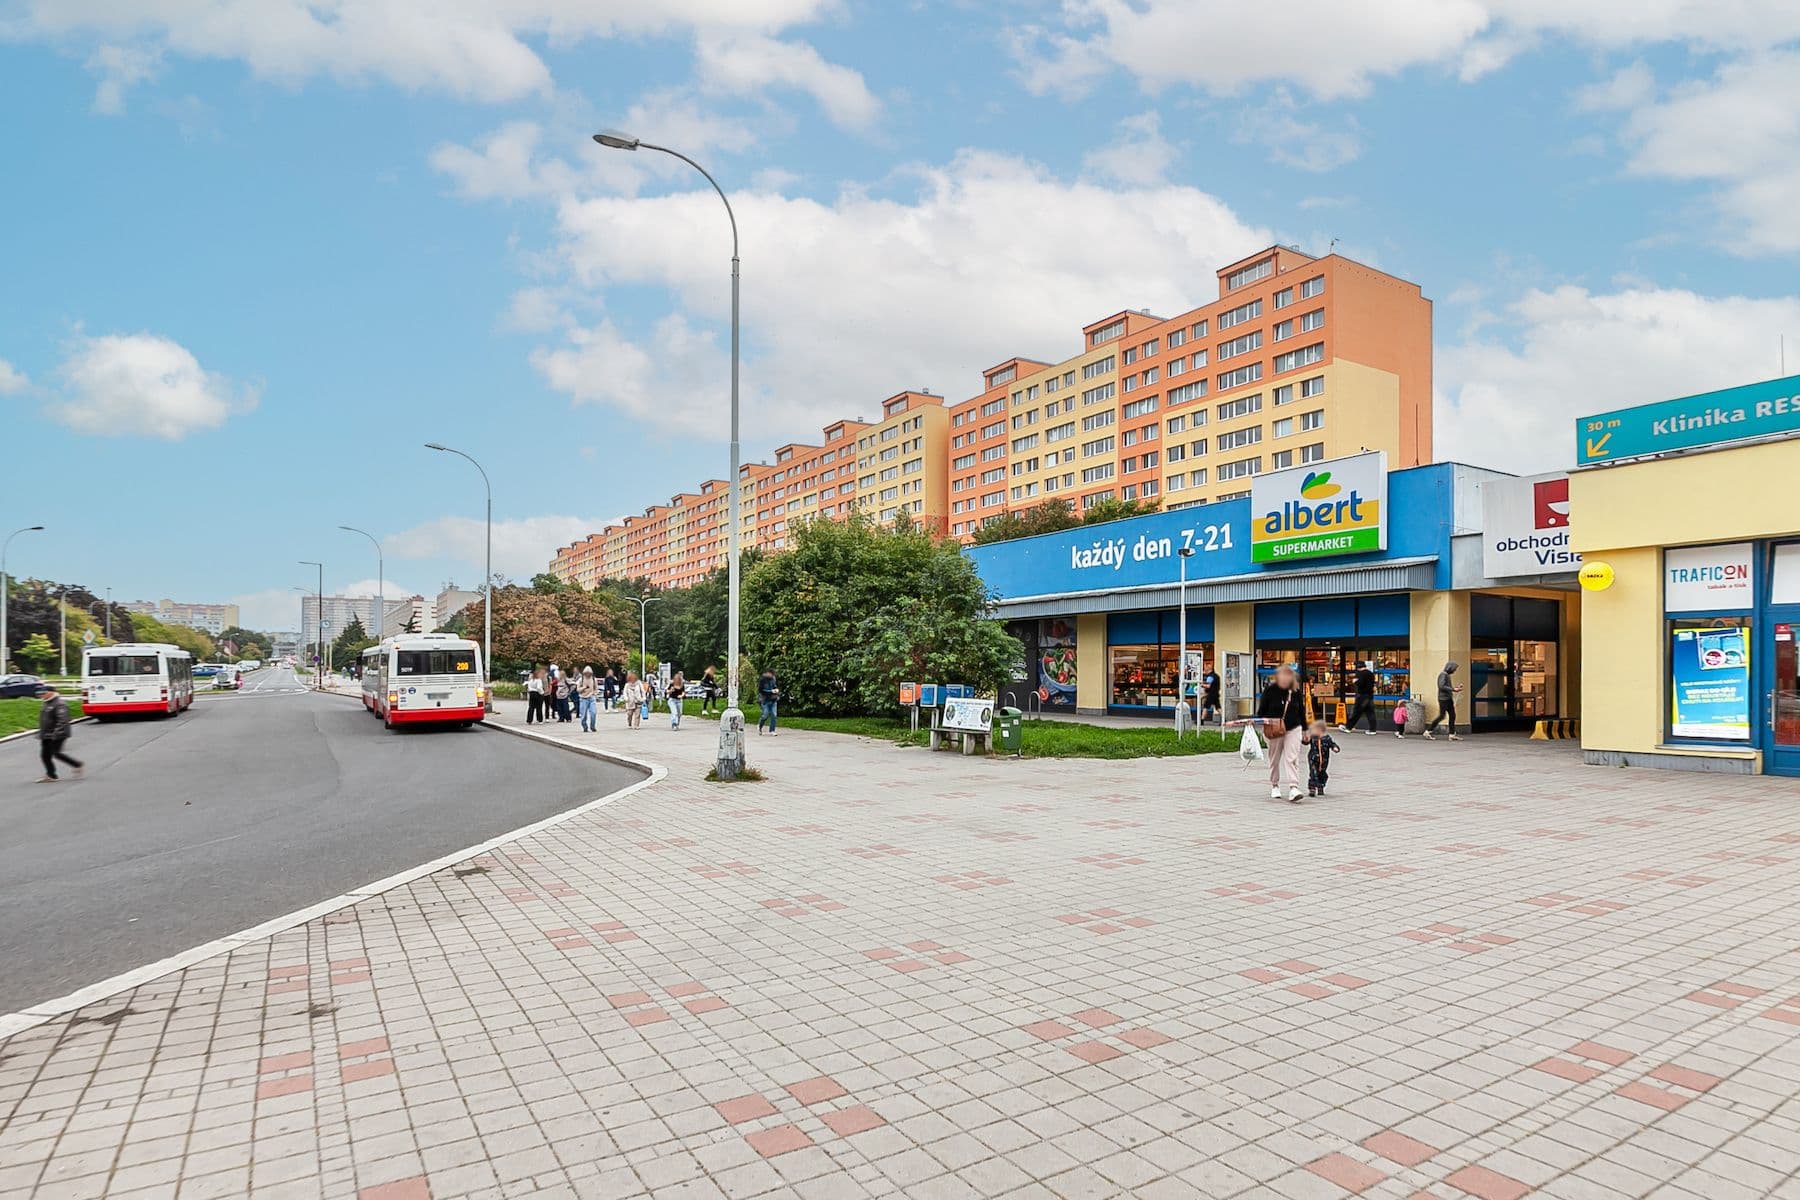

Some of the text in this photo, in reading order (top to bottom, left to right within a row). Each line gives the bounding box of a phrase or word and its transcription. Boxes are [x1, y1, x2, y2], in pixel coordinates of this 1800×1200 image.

[1587, 419, 1621, 433] 30 m
[1653, 407, 1747, 436] Klinika
[1265, 490, 1363, 534] albert
[1071, 523, 1233, 571] každý den 7-21
[1272, 536, 1354, 557] SUPERMARKET
[1671, 564, 1748, 583] TRAFICON
[456, 662, 469, 671] 200
